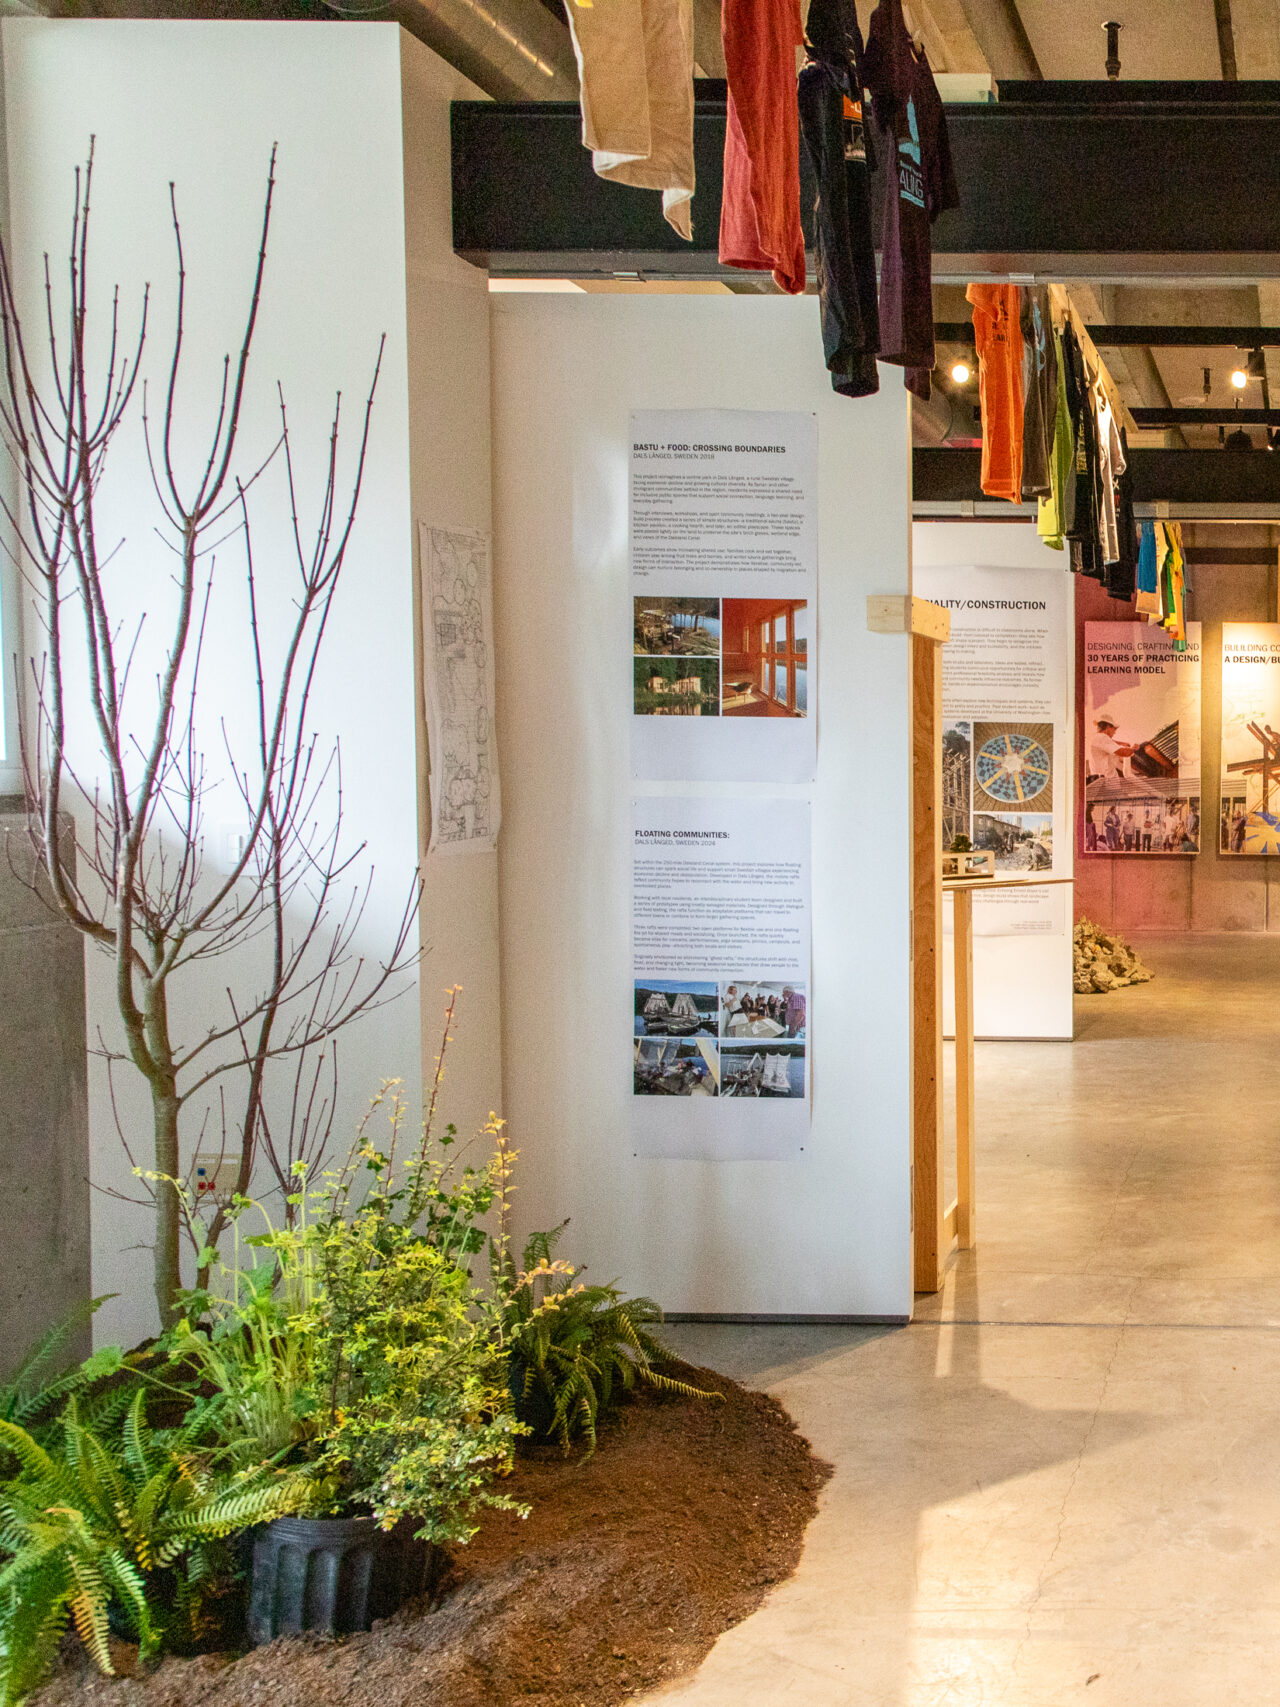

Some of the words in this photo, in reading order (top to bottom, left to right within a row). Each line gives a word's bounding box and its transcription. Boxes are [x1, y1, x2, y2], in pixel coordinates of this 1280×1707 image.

[633, 443, 659, 451] BASTU
[667, 444, 691, 452] FOOD:
[693, 444, 733, 453] CROSSING
[734, 445, 786, 454] BOUNDARIES
[924, 599, 1046, 611] ALITY/CONSTRUCTION
[1137, 643, 1173, 652] CRAFTIN
[1087, 654, 1099, 662] 30
[1101, 654, 1129, 662] YEARS
[1131, 654, 1144, 662] OF
[1146, 654, 1199, 662] PRACTICING
[1087, 666, 1131, 676] LEARNING
[1134, 667, 1165, 676] MODEL
[635, 830, 671, 838] FLOATING
[672, 831, 730, 839] COMMUNITIES:
